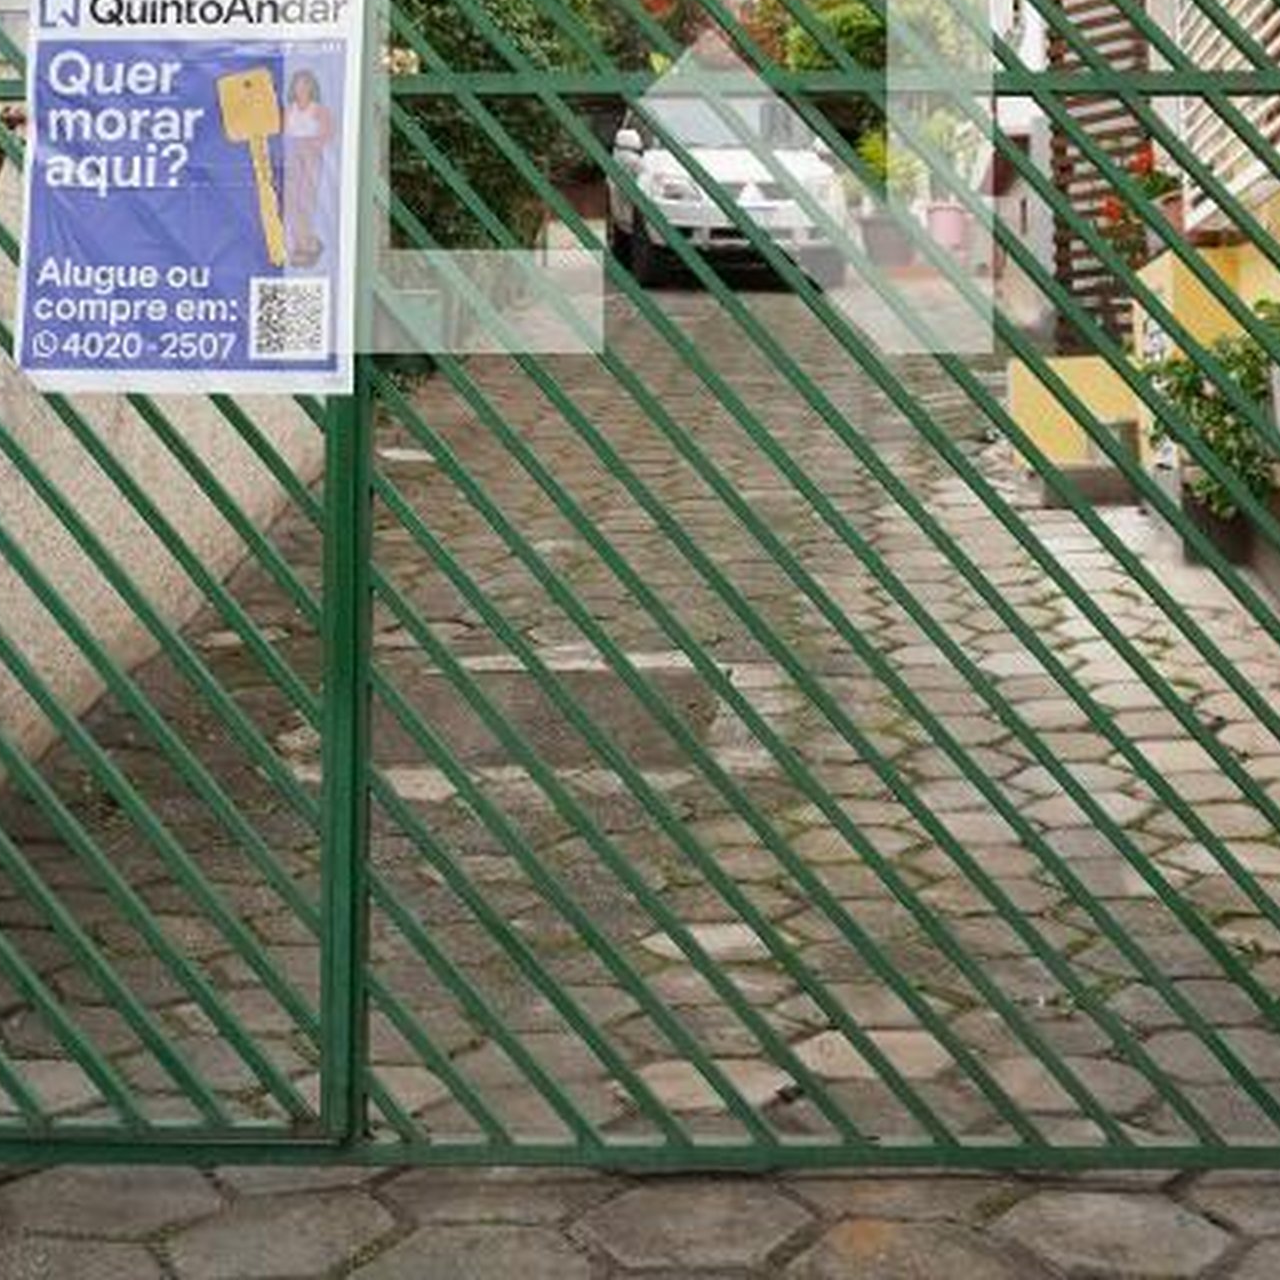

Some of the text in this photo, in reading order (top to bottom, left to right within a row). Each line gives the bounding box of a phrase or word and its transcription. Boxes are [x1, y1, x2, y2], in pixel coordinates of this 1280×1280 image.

[48, 50, 181, 96] Quer
[48, 106, 204, 143] morar
[45, 144, 188, 197] aqui?
[37, 257, 210, 294] Alugue ou
[34, 298, 239, 326] compre em:
